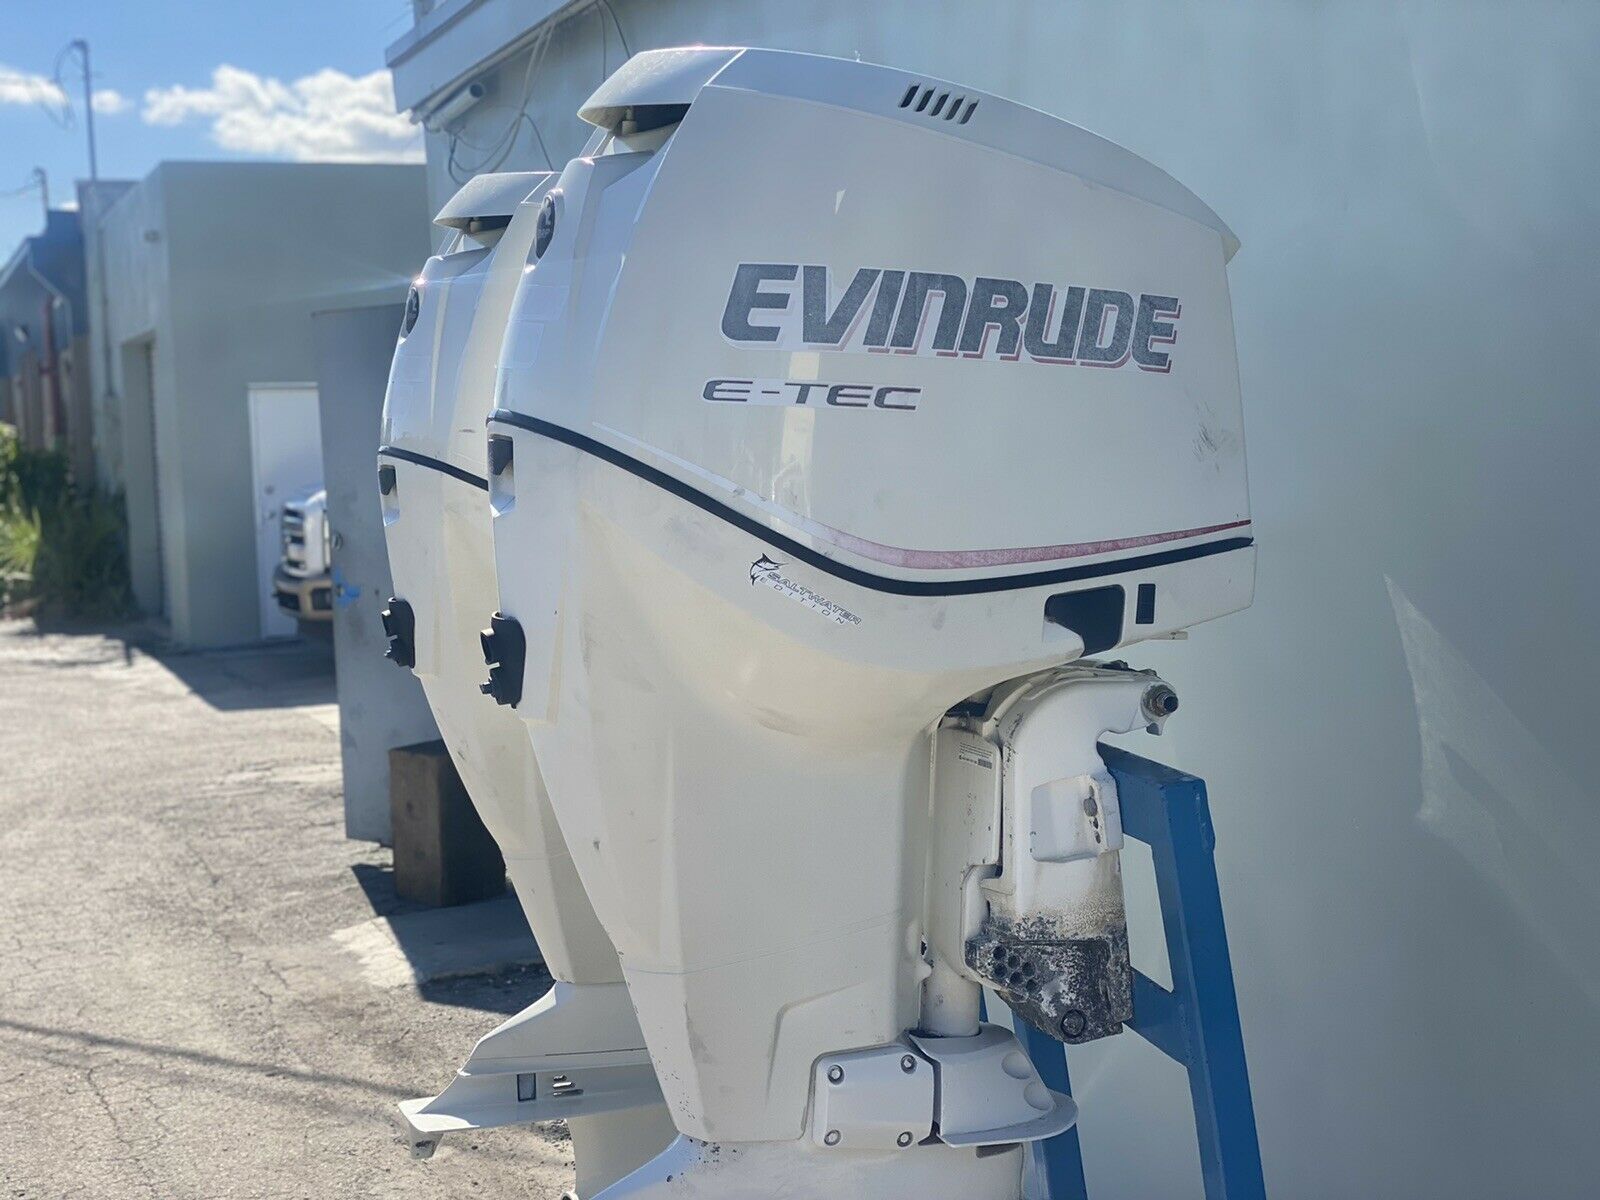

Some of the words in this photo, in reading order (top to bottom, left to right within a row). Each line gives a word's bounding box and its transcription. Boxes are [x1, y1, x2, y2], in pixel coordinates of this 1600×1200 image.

[720, 263, 1182, 373] EVINRUDE
[703, 379, 923, 411] E-TEC
[767, 571, 862, 625] SALTWATER
